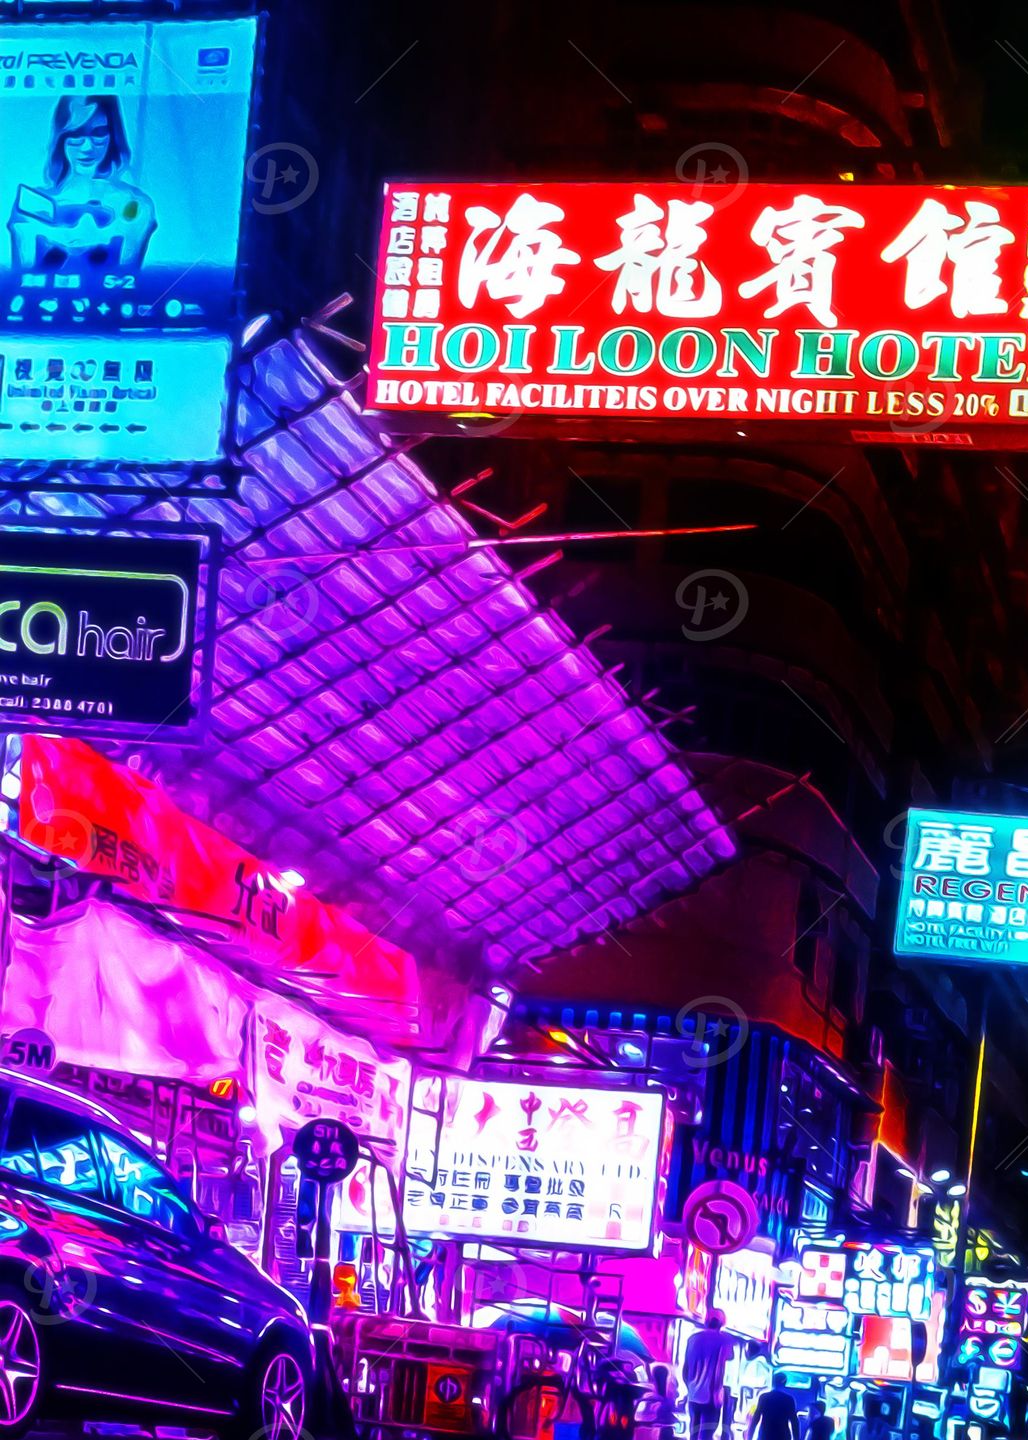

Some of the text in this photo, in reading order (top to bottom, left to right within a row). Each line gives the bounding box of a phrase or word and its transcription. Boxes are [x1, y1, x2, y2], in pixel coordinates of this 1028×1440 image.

[458, 193, 1015, 329] 海龍賓館
[378, 322, 537, 374] HOI
[547, 326, 779, 378] LOON
[375, 379, 479, 407] HOTEL
[663, 386, 749, 412] OVER
[755, 388, 859, 414] NIGHT
[867, 391, 945, 416] LESS
[77, 610, 166, 661] hair
[692, 1138, 768, 1176] Venus
